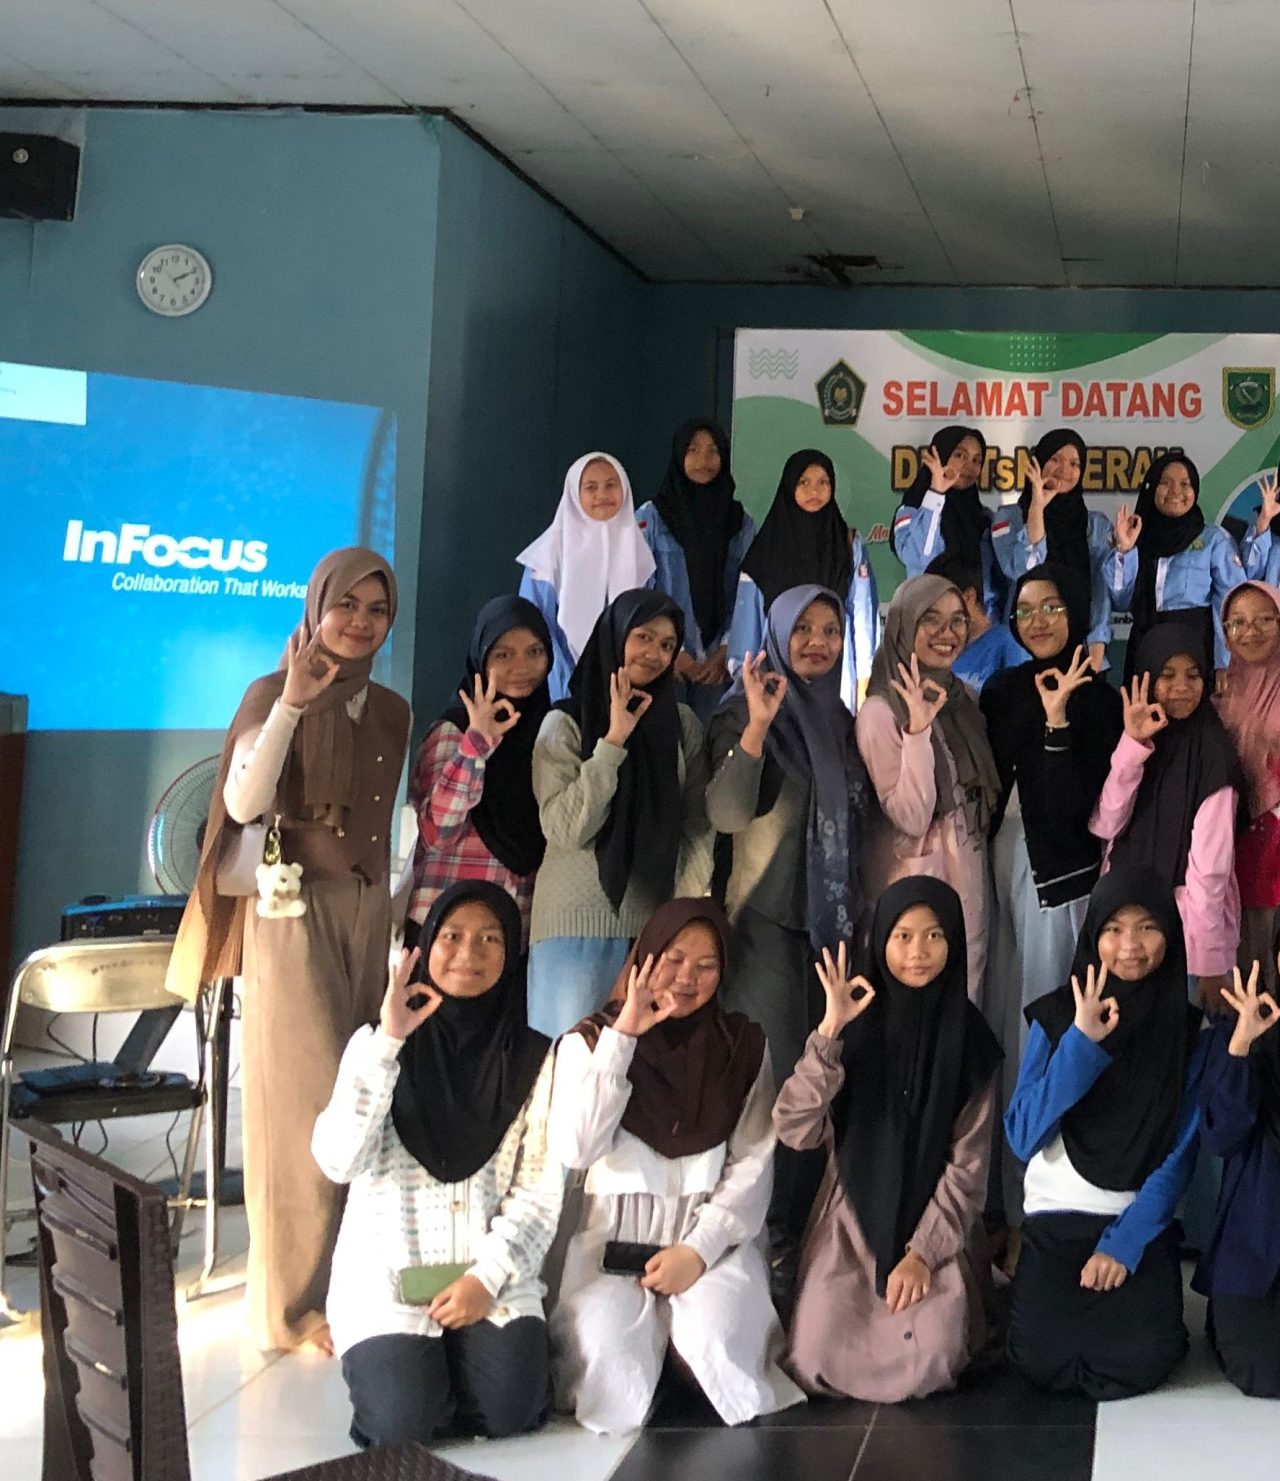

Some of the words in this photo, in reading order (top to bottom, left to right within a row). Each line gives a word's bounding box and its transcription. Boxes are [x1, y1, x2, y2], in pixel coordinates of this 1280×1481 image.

[882, 380, 1049, 417] SELAMAT
[1061, 382, 1202, 418] DATANG
[891, 446, 931, 492] D
[1079, 446, 1186, 492] ERA
[63, 519, 269, 573] InFocus
[112, 571, 220, 595] Collaboration
[223, 577, 258, 596] That
[261, 579, 309, 599] Works
